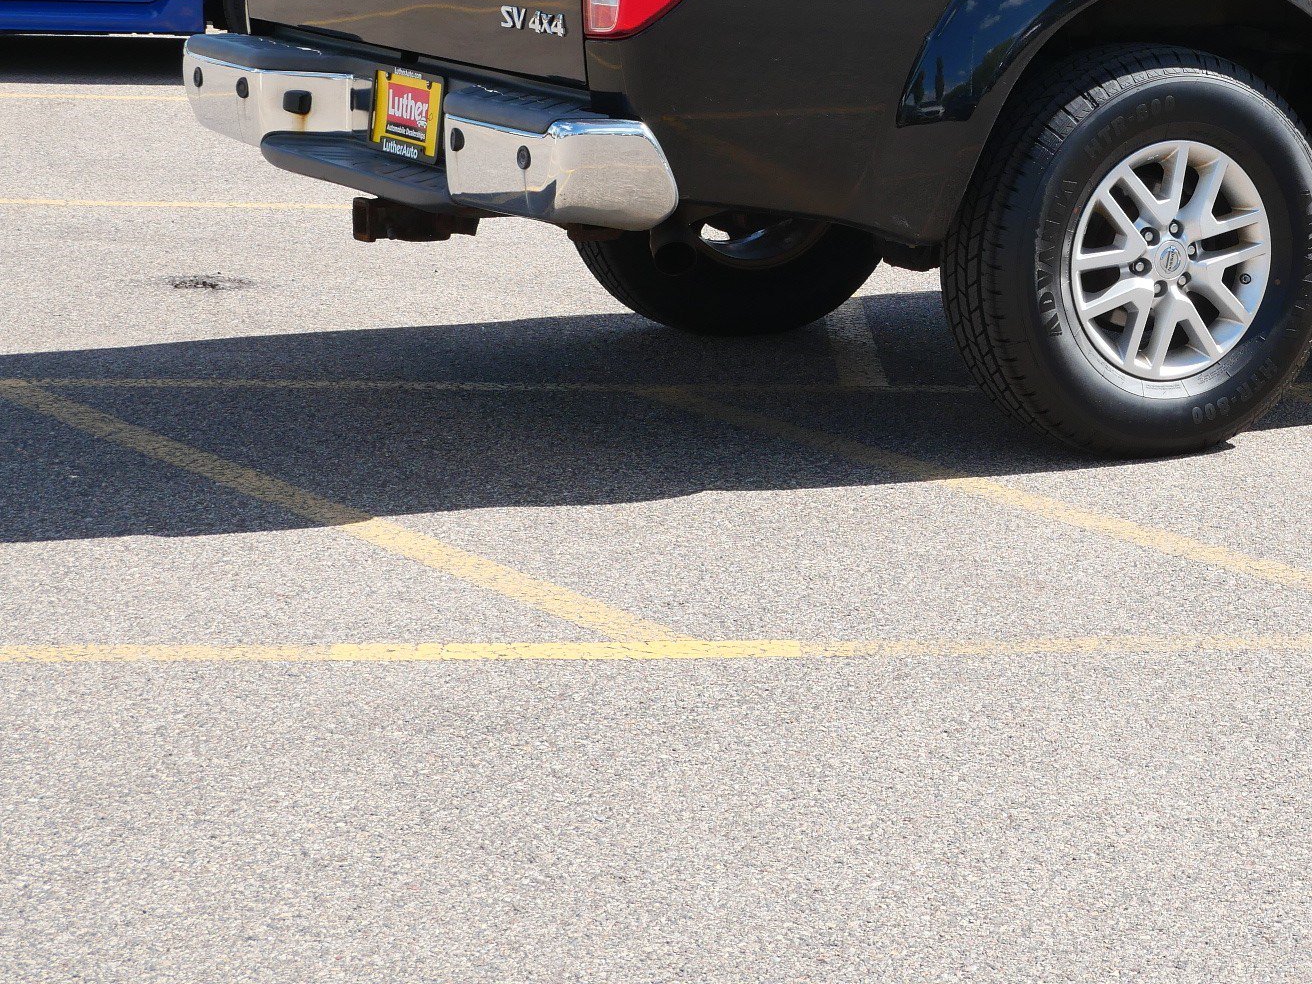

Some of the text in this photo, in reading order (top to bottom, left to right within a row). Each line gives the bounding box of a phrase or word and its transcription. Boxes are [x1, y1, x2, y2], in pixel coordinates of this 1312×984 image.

[500, 5, 527, 30] SV
[388, 88, 429, 121] Luther
[382, 138, 418, 159] LutherAuto
